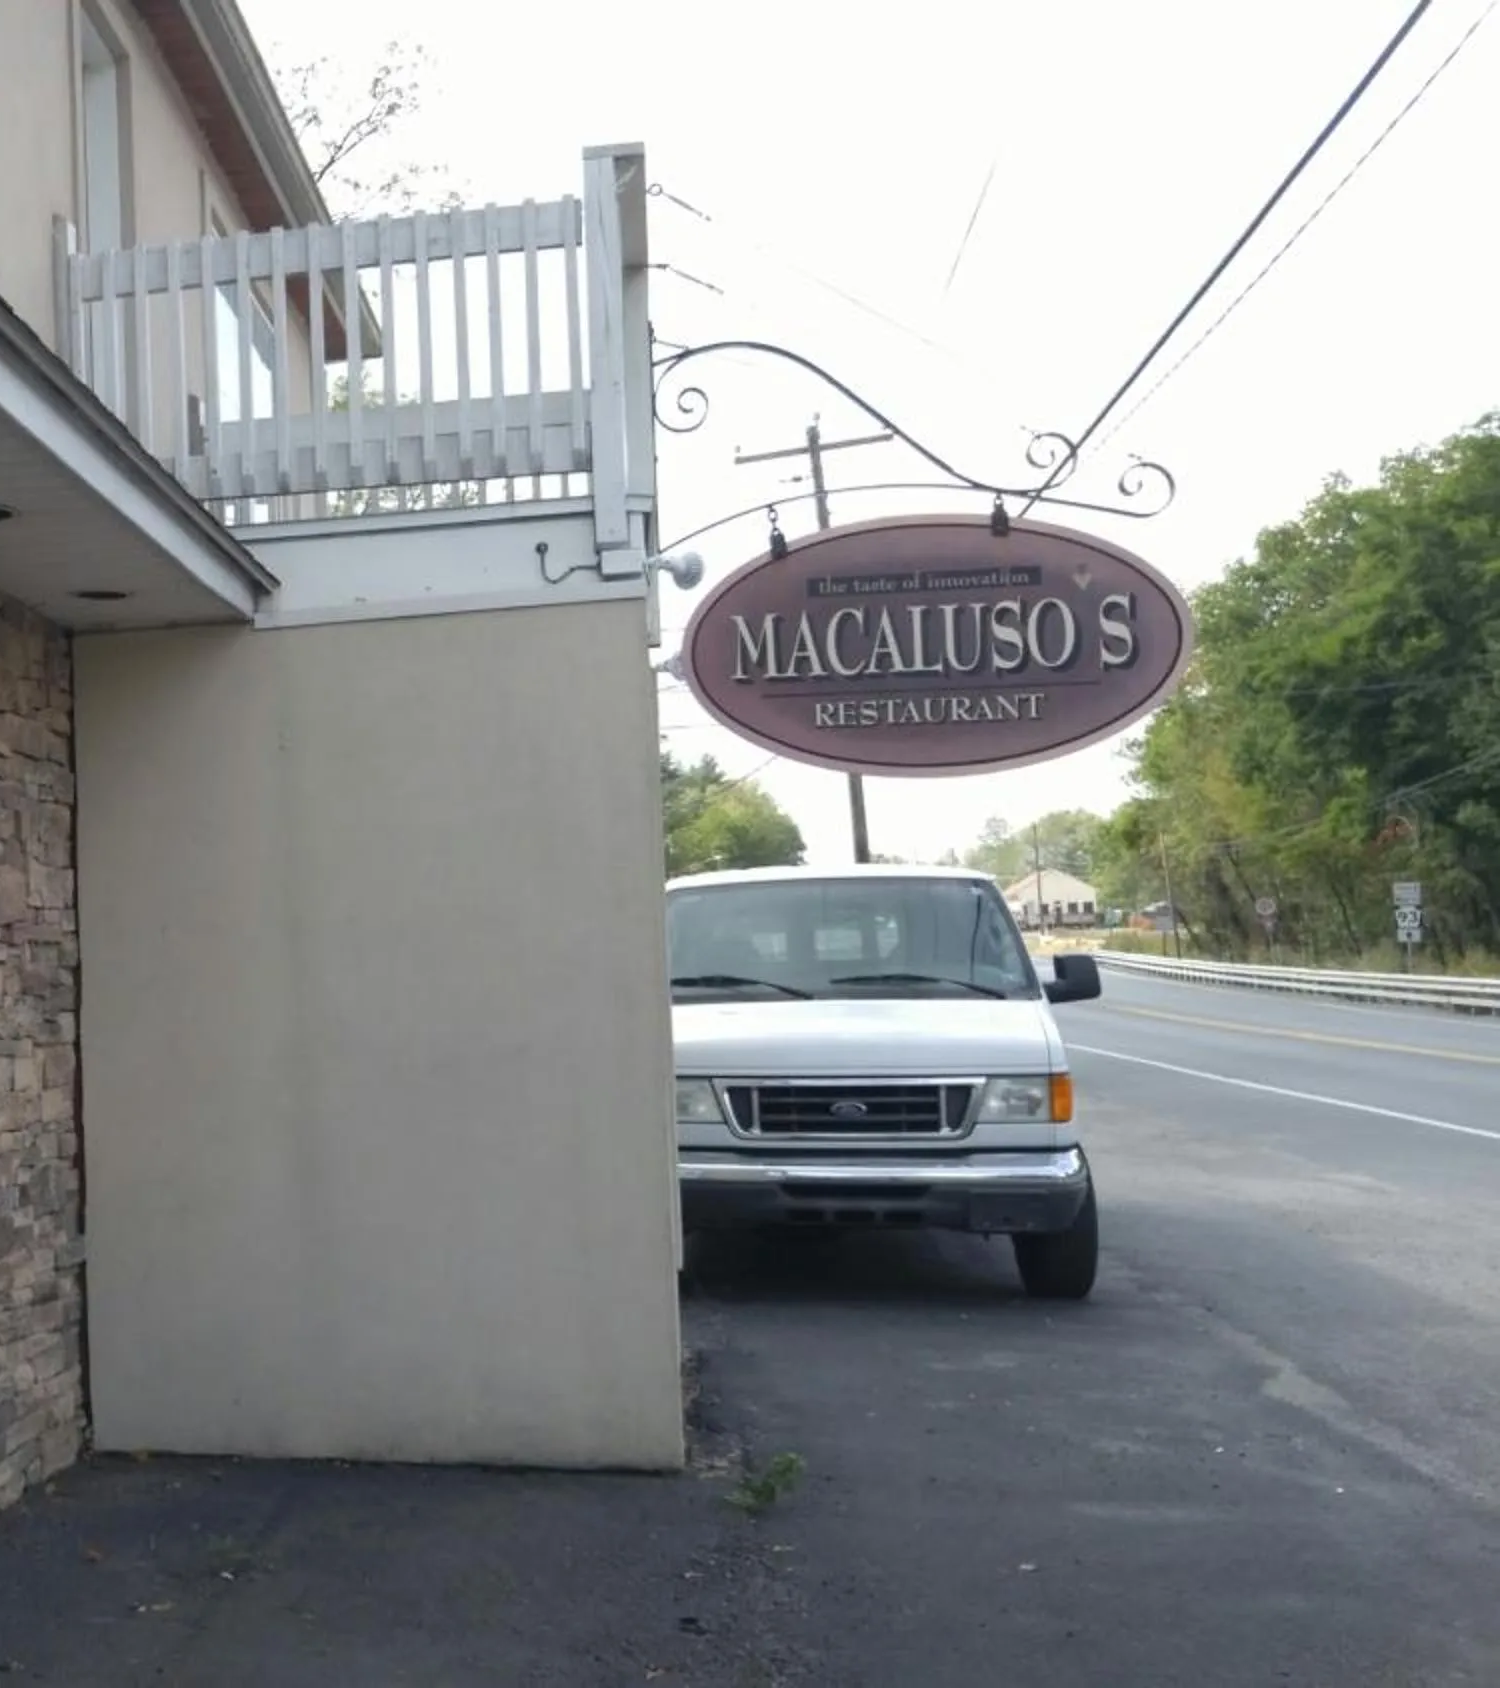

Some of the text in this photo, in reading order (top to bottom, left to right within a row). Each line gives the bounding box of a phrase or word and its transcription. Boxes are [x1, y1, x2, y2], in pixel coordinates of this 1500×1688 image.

[818, 574, 848, 594] the
[852, 571, 897, 593] taste
[902, 569, 922, 590] of
[814, 693, 1045, 729] RESTAURANT
